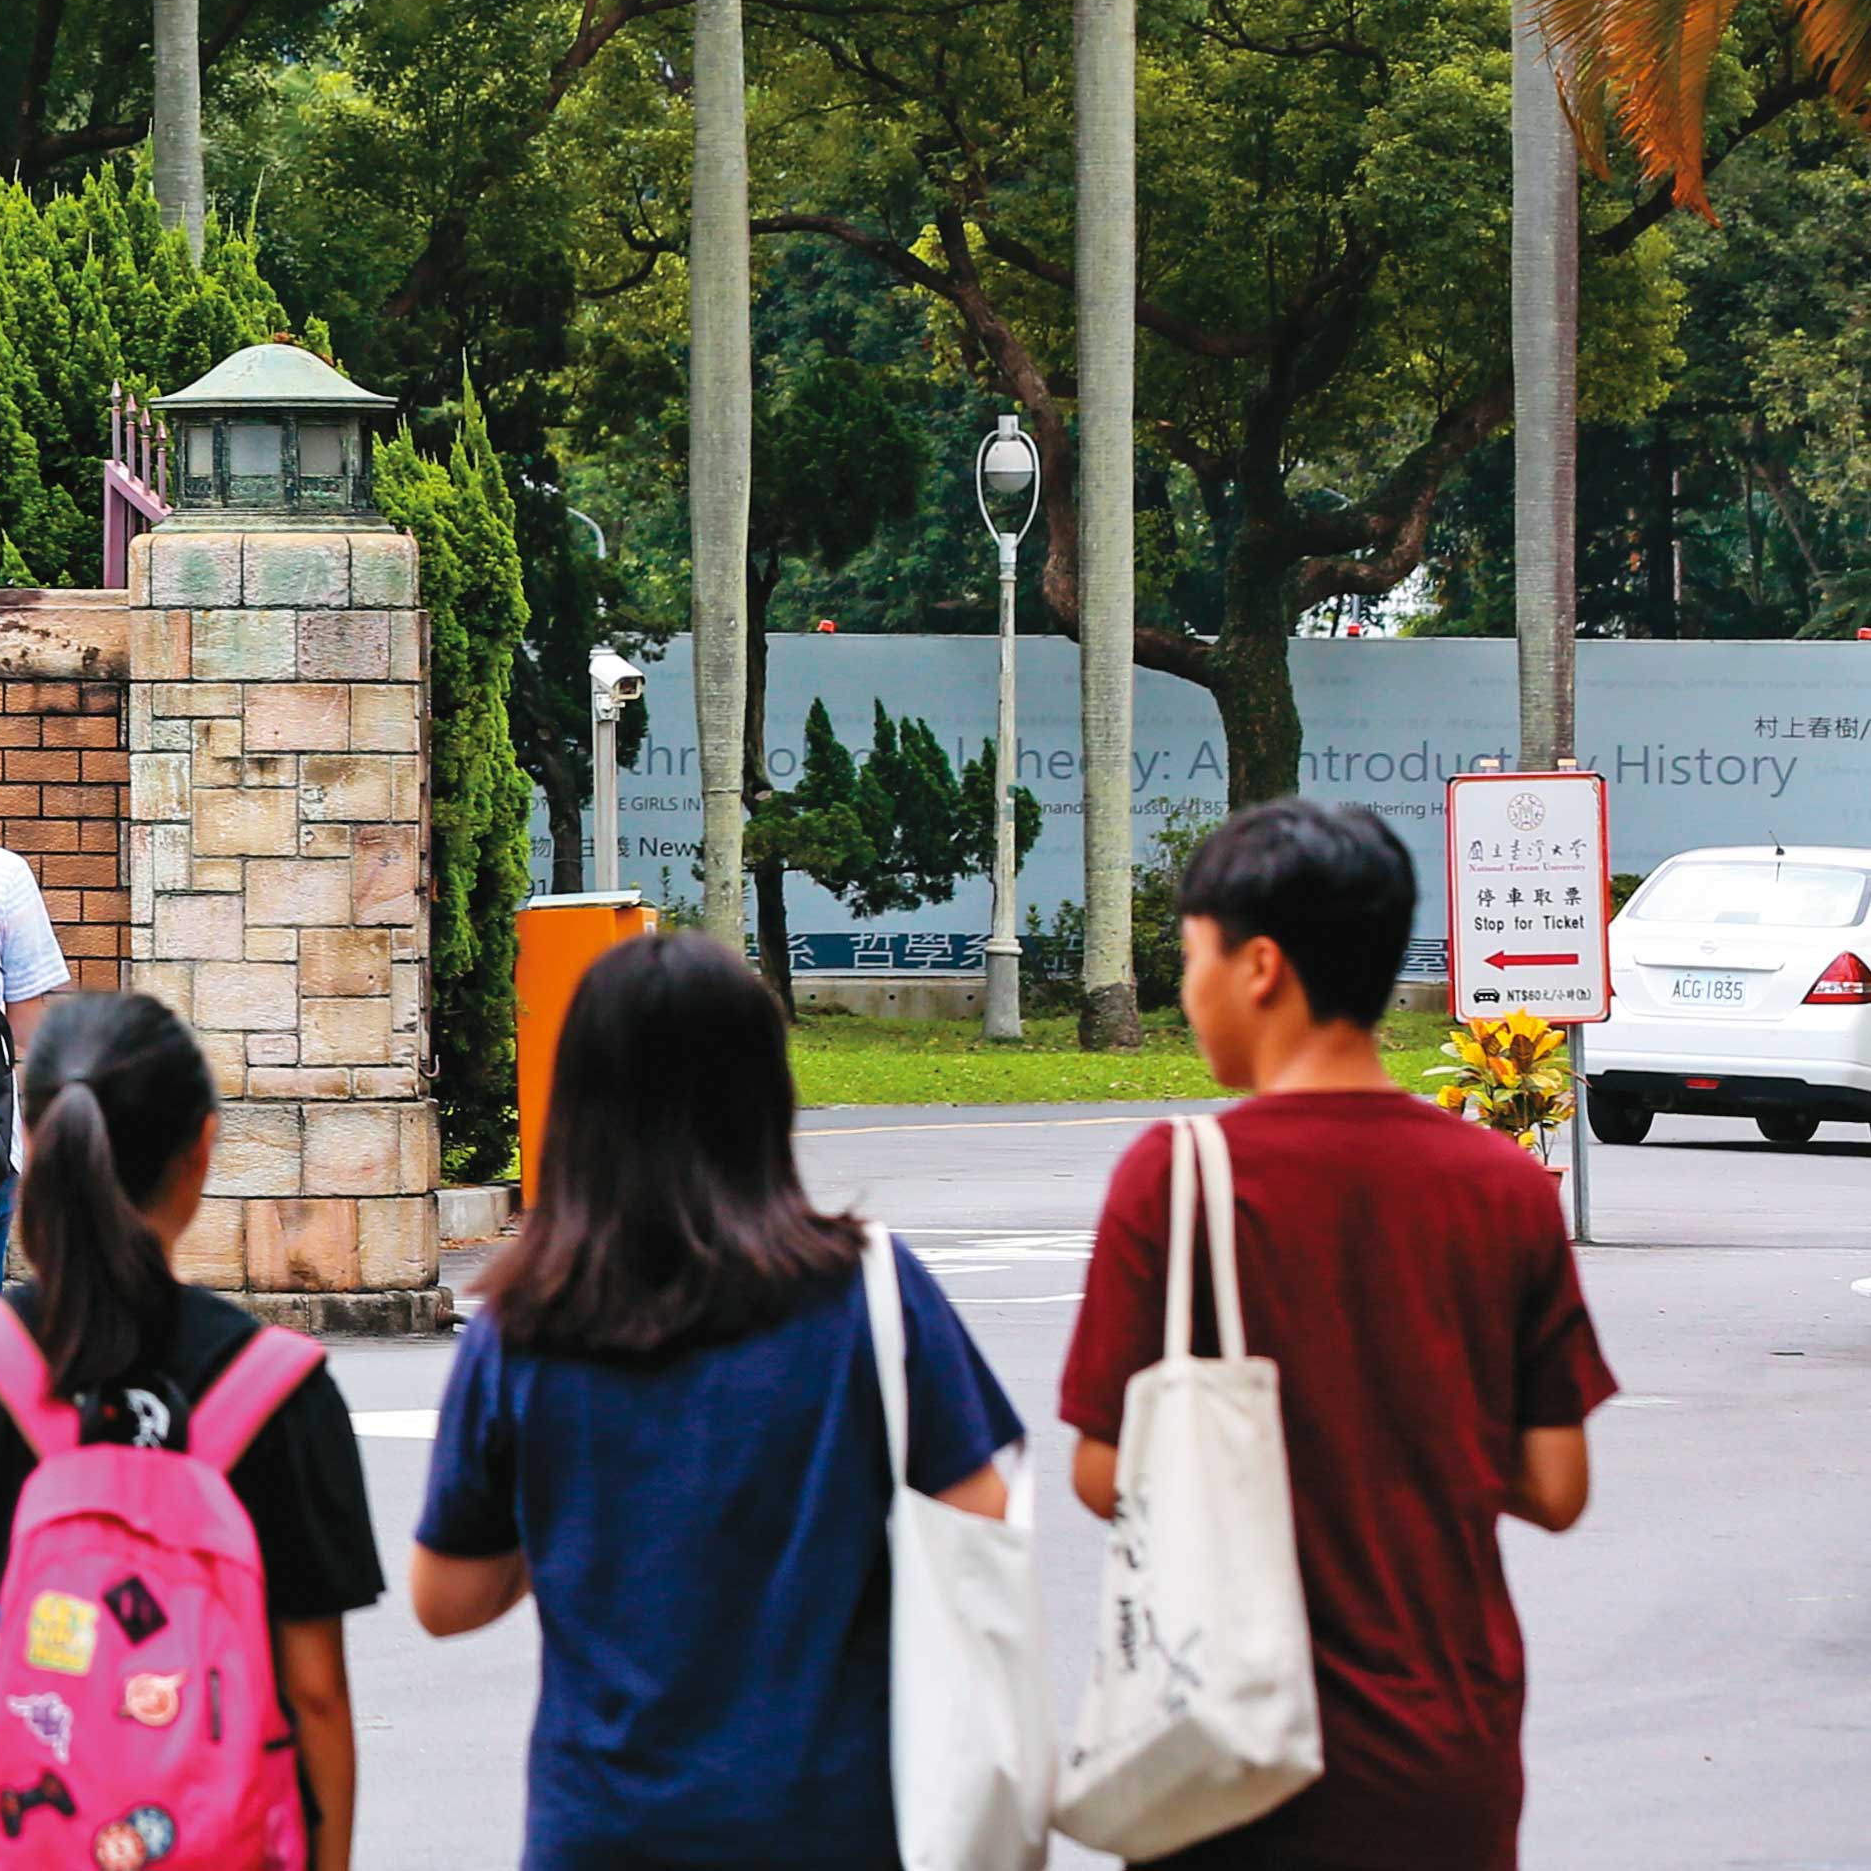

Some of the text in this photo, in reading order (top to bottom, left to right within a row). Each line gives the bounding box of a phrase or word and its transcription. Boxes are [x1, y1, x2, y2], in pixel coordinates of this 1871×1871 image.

[1616, 744, 1798, 797] History
[631, 796, 678, 811] GIRLS
[1468, 862, 1586, 872] National Taiwan University
[1477, 887, 1582, 908] 停車取票
[1474, 914, 1585, 934] Stop for Ticket
